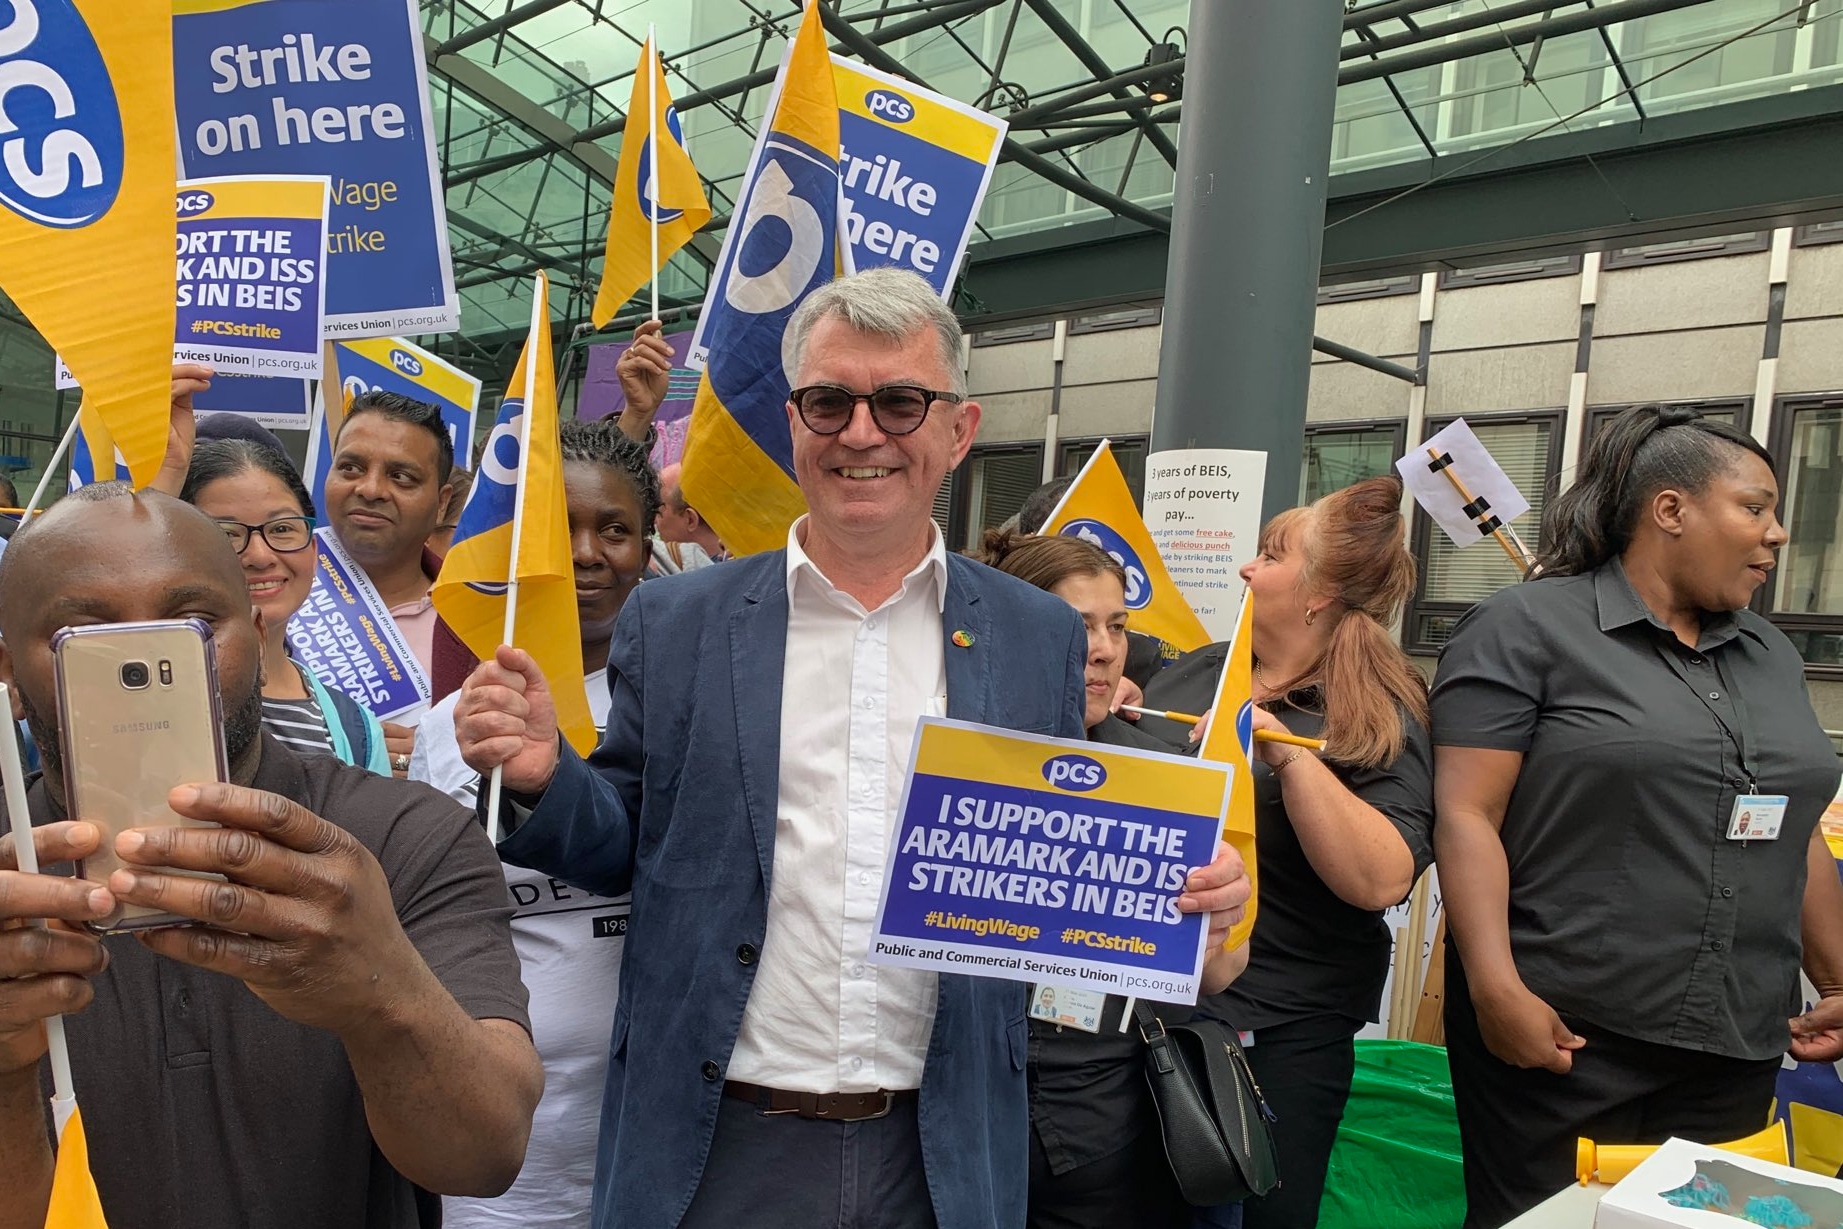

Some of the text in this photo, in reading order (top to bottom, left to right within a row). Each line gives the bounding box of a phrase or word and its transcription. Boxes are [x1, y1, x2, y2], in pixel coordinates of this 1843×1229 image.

[210, 33, 372, 94] Strike
[869, 90, 911, 121] pcs
[196, 97, 405, 156] on here
[839, 144, 937, 216] trike
[176, 230, 292, 256] ORT THE
[327, 225, 386, 254] trike
[842, 197, 940, 273] here
[176, 256, 315, 284] K AND ISS
[176, 283, 302, 312] S IN BEIS
[191, 319, 281, 340] #PCSstrike
[324, 313, 448, 332] ervices Union pcs.org.uk
[174, 350, 318, 371] rvices Union pcs.org.uk
[392, 352, 422, 374] pcs
[1152, 464, 1231, 480] 3 years of BEIS,
[1151, 490, 1171, 503] years
[1174, 487, 1186, 499] of
[1188, 489, 1240, 502] poverty
[1165, 510, 1195, 522] pay...
[1163, 529, 1173, 537] get
[1196, 529, 1213, 537] free
[1171, 541, 1204, 549] delicious
[1205, 542, 1231, 550] punch
[1173, 553, 1182, 562] by
[1184, 554, 1213, 563] striking
[349, 564, 365, 586] Union
[1206, 581, 1229, 589] strike
[363, 586, 384, 616] Services
[1201, 607, 1216, 615] far!
[319, 553, 402, 682] #LivingWage #PCSstrike
[311, 588, 391, 704] STRIKERS IN
[380, 616, 409, 659] Commercial
[305, 617, 376, 715] RAMARK
[406, 659, 419, 676] and
[415, 675, 432, 699] Public
[113, 720, 170, 734] SAMSUNG
[1049, 759, 1101, 786] pcs
[938, 794, 1187, 858] I SUPPORT THE
[901, 825, 1077, 876] ARAMARK
[1074, 850, 1152, 885] AND
[908, 862, 1183, 925] STRIKERS IN BEIS
[924, 911, 1156, 956] #LivingWage #PCSstrike
[875, 942, 1192, 994] Public and Commercial Services Union pcs.org.uk
